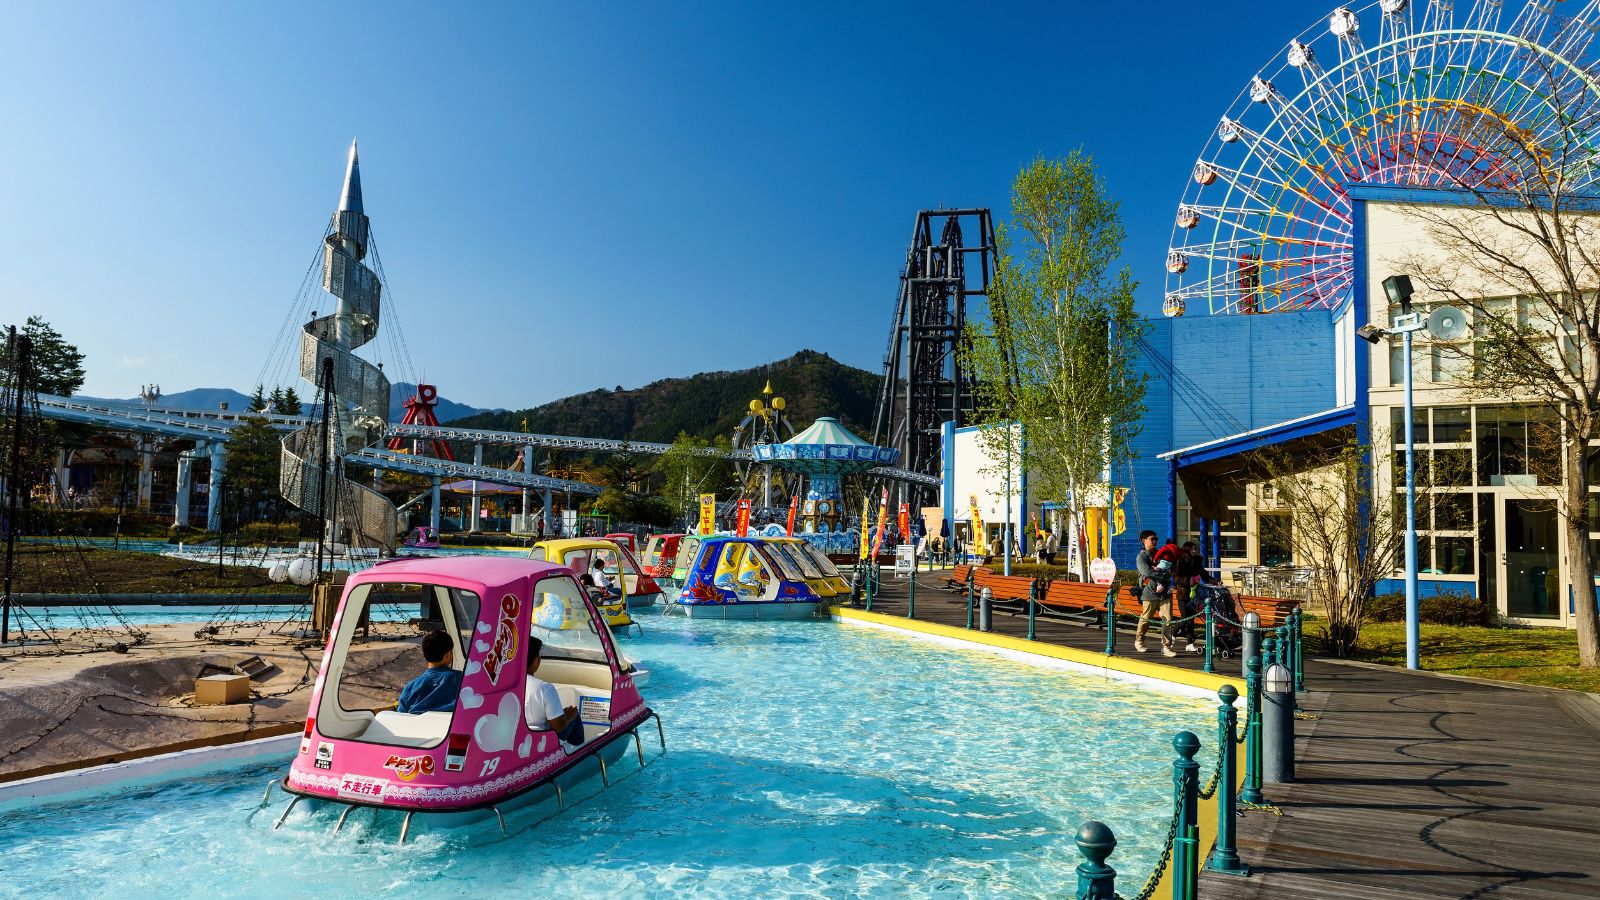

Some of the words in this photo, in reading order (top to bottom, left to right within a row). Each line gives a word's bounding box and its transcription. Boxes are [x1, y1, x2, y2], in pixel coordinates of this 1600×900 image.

[478, 757, 501, 778] 19
[342, 780, 383, 796] 不走行車
